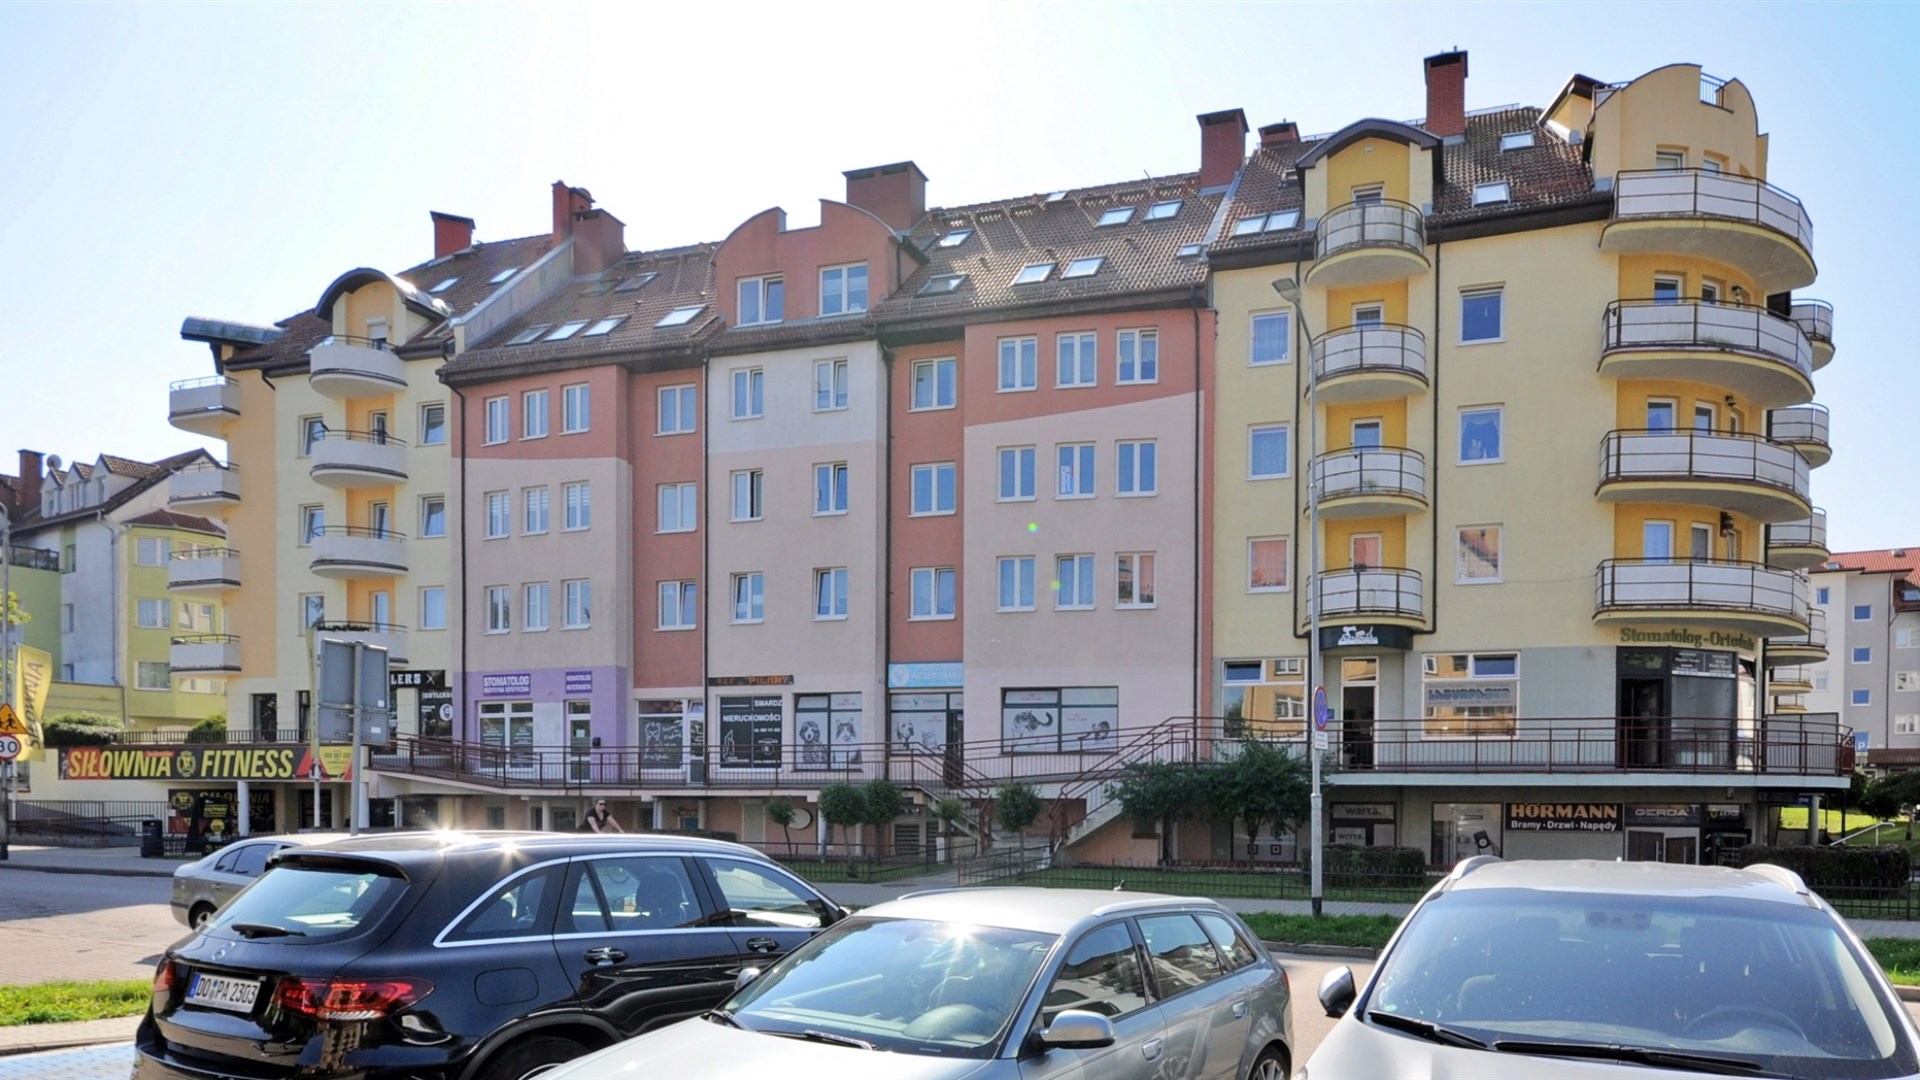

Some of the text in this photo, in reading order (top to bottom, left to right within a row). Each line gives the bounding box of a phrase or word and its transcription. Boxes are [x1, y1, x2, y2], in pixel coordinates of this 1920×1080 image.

[483, 675, 529, 687] STOMATOLOG
[723, 712, 781, 722] NIERUCHOMOŚCI
[69, 749, 294, 778] SIŁOWNIA FITNESS
[1511, 803, 1617, 818] HÖRMANN
[1635, 808, 1688, 816] GERDA
[1511, 820, 1617, 831] Bramy Drzwi Napędy
[196, 977, 258, 1004] DO PA 2303
